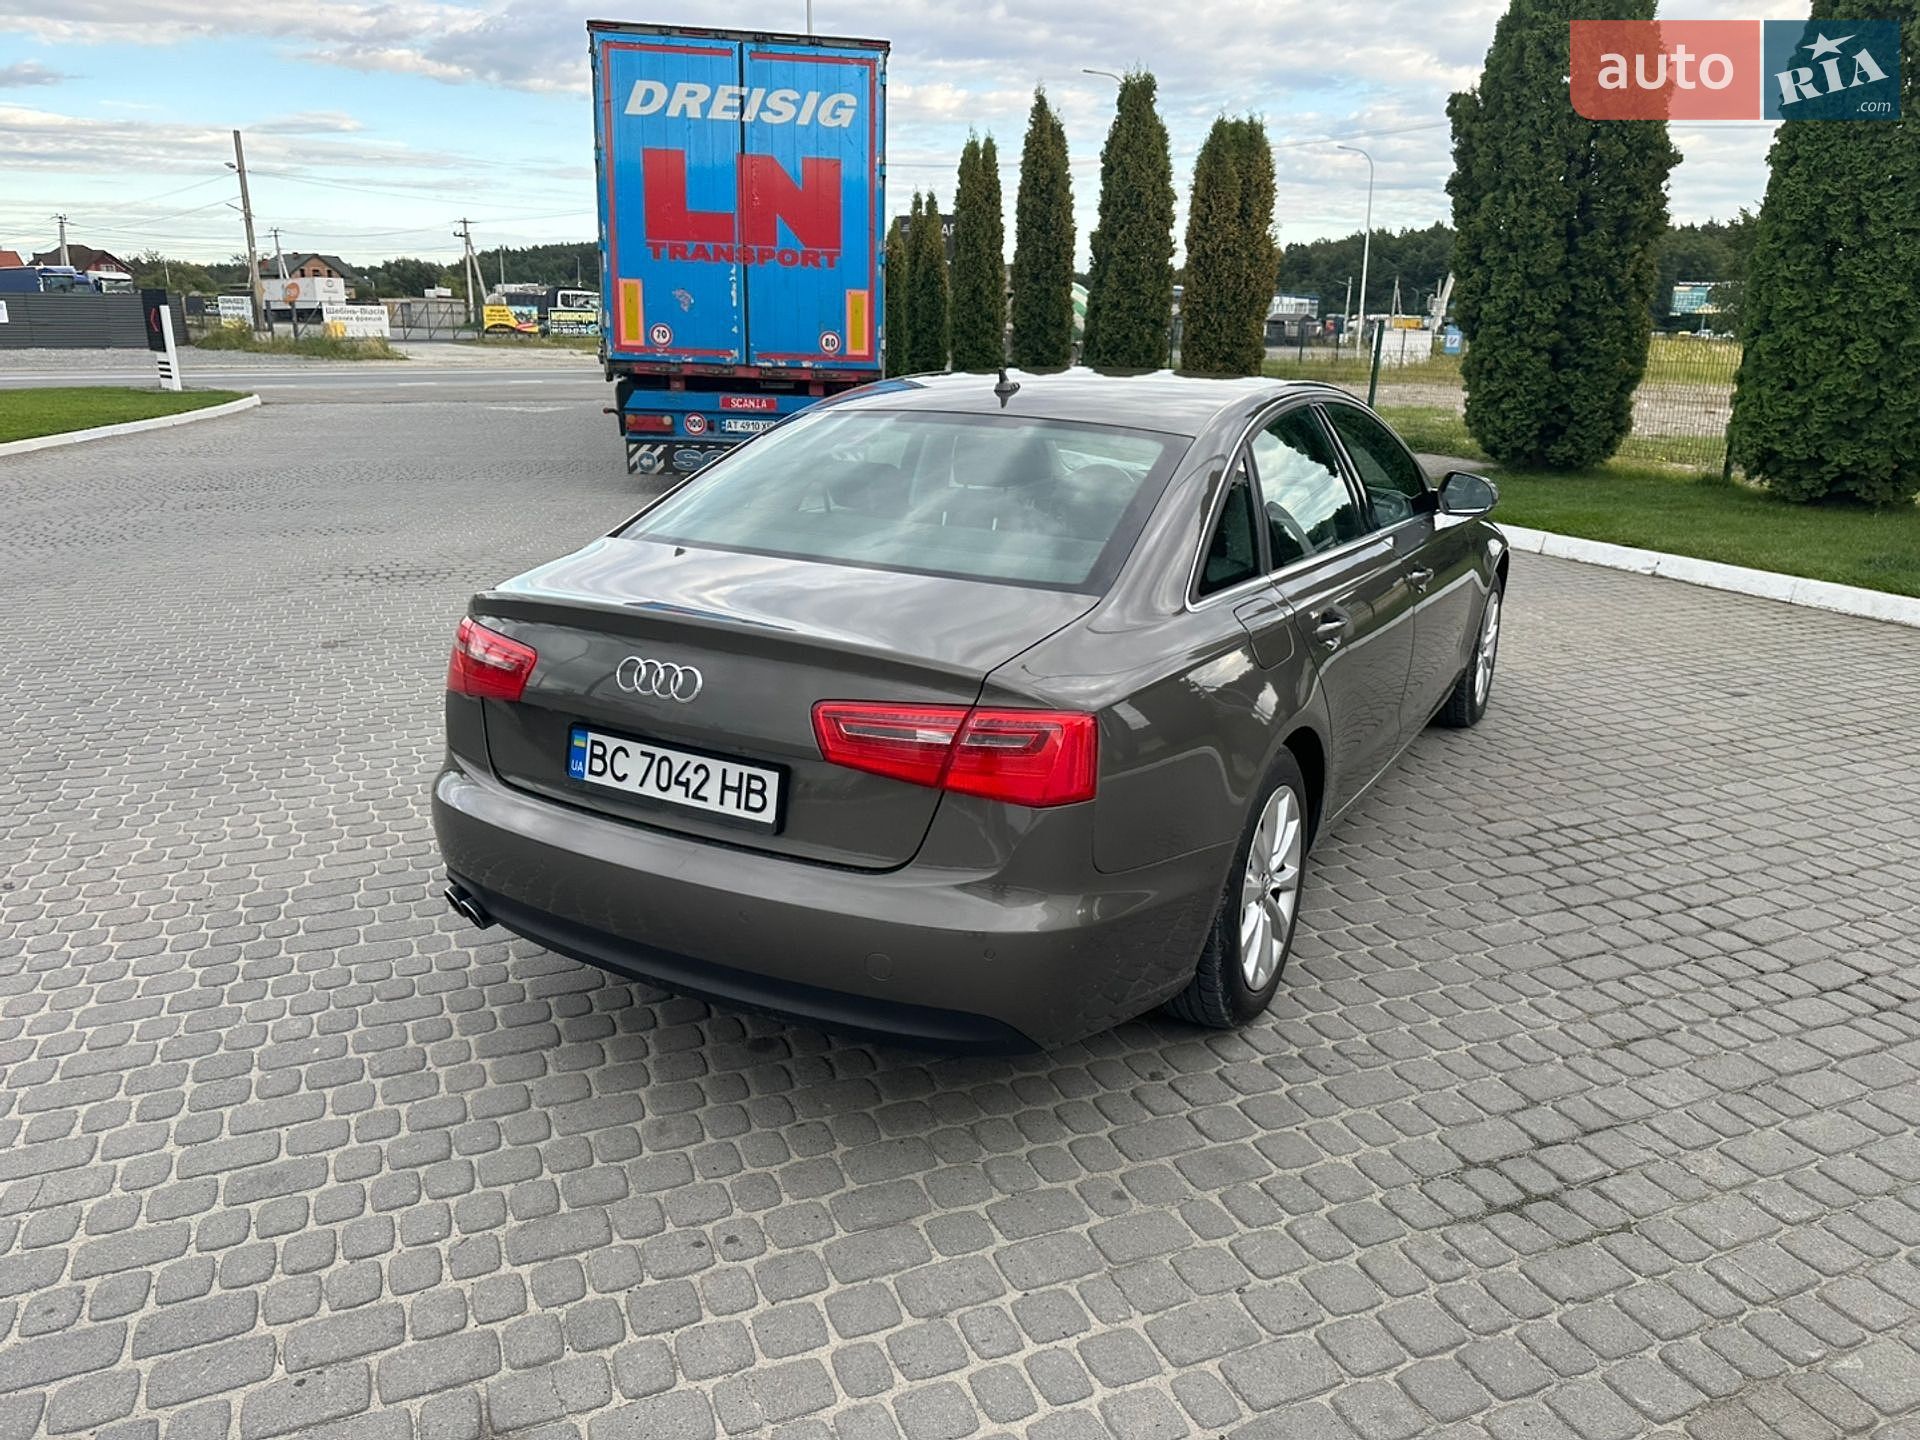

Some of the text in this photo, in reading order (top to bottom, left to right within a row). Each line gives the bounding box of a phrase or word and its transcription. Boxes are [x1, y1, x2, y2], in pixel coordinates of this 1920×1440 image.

[624, 79, 857, 128] DREISIG
[642, 148, 842, 249] LN
[647, 242, 841, 269] TRANSPORT
[655, 329, 668, 340] 70
[824, 338, 836, 347] 80
[730, 397, 767, 408] SCANIA
[687, 419, 703, 429] 100
[727, 421, 738, 429] AT
[740, 421, 760, 430] 4910
[571, 759, 584, 773] UA
[587, 740, 768, 814] BC 7042 HB
